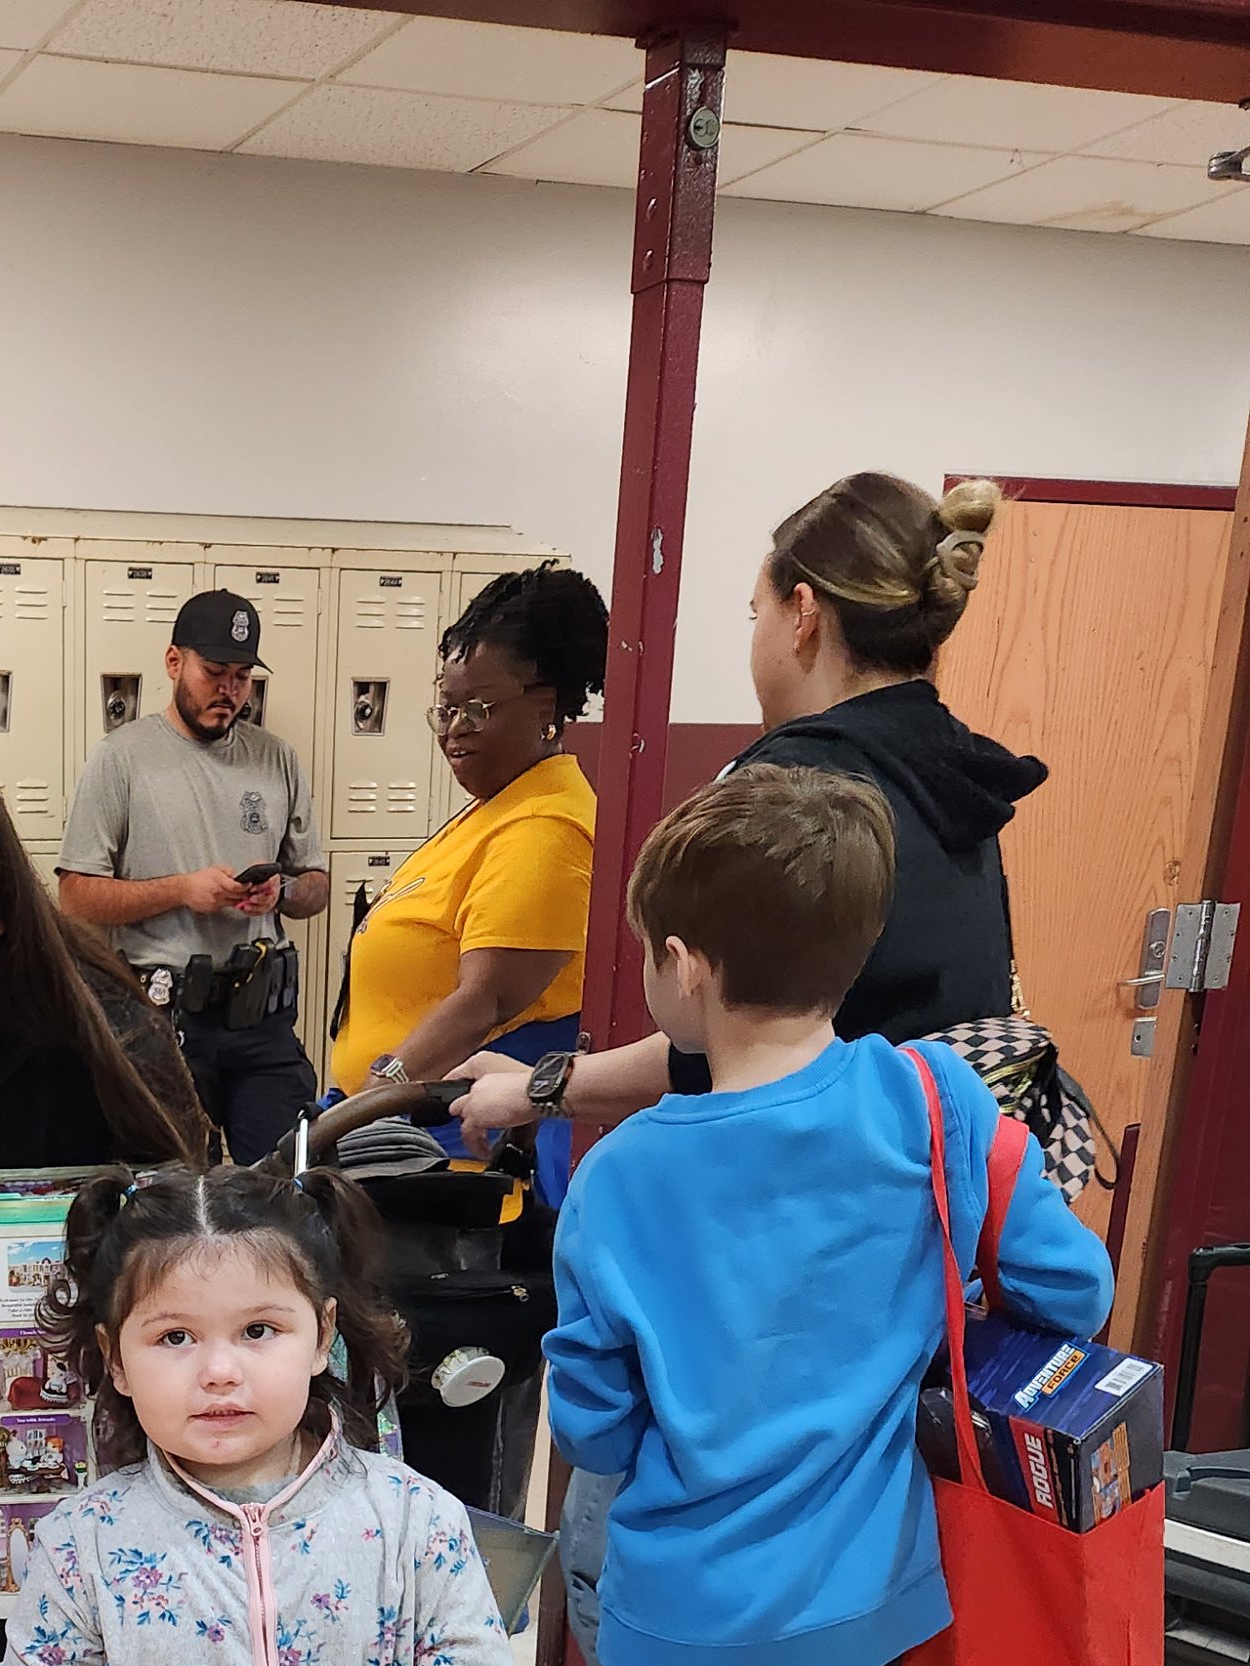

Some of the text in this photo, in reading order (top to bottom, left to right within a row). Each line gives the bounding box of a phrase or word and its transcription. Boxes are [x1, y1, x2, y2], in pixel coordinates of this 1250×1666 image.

[1014, 1343, 1075, 1409] ADVENTURE
[1047, 1355, 1078, 1390] FORCE
[1024, 1432, 1054, 1510] ROGUE
